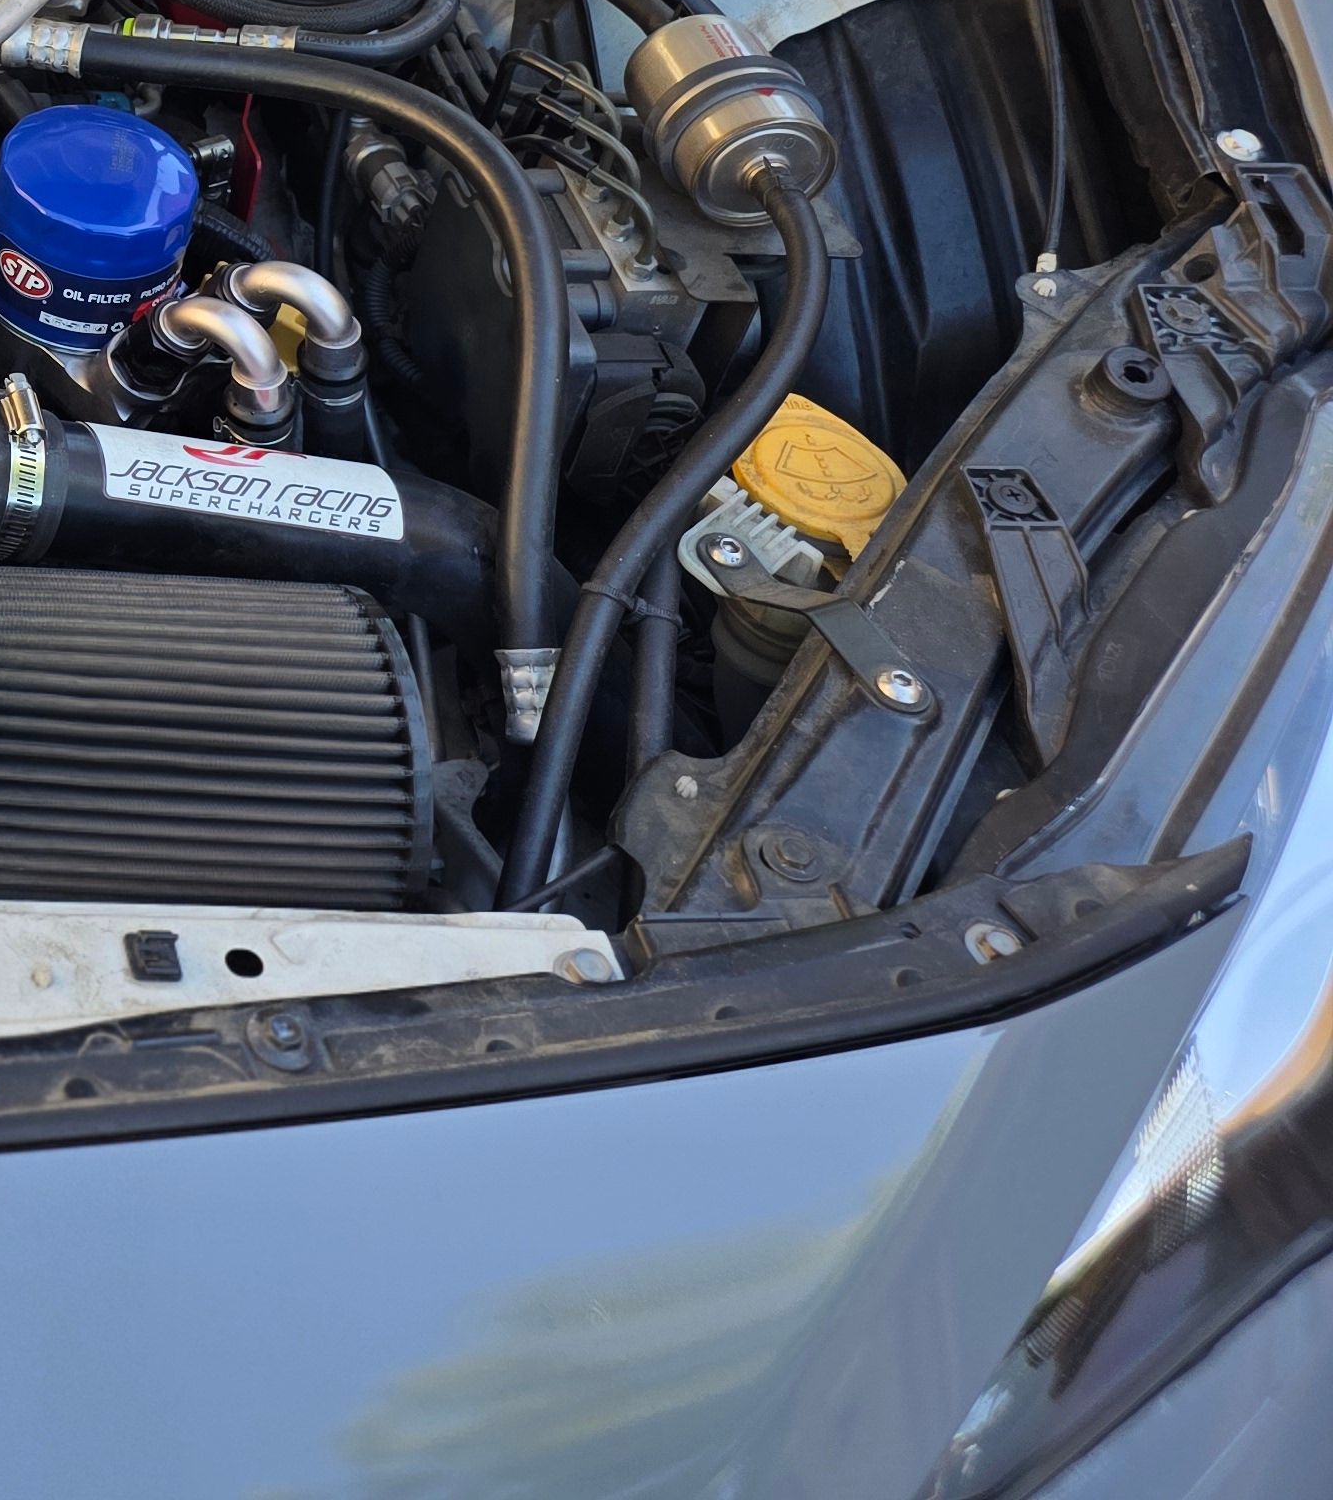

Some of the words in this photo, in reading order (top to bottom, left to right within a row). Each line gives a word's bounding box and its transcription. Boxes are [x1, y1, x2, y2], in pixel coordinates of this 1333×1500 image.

[2, 257, 46, 292] STP
[63, 288, 84, 302] OIL
[88, 293, 132, 304] FILTER
[127, 483, 381, 533] SUPERCHARGERS
